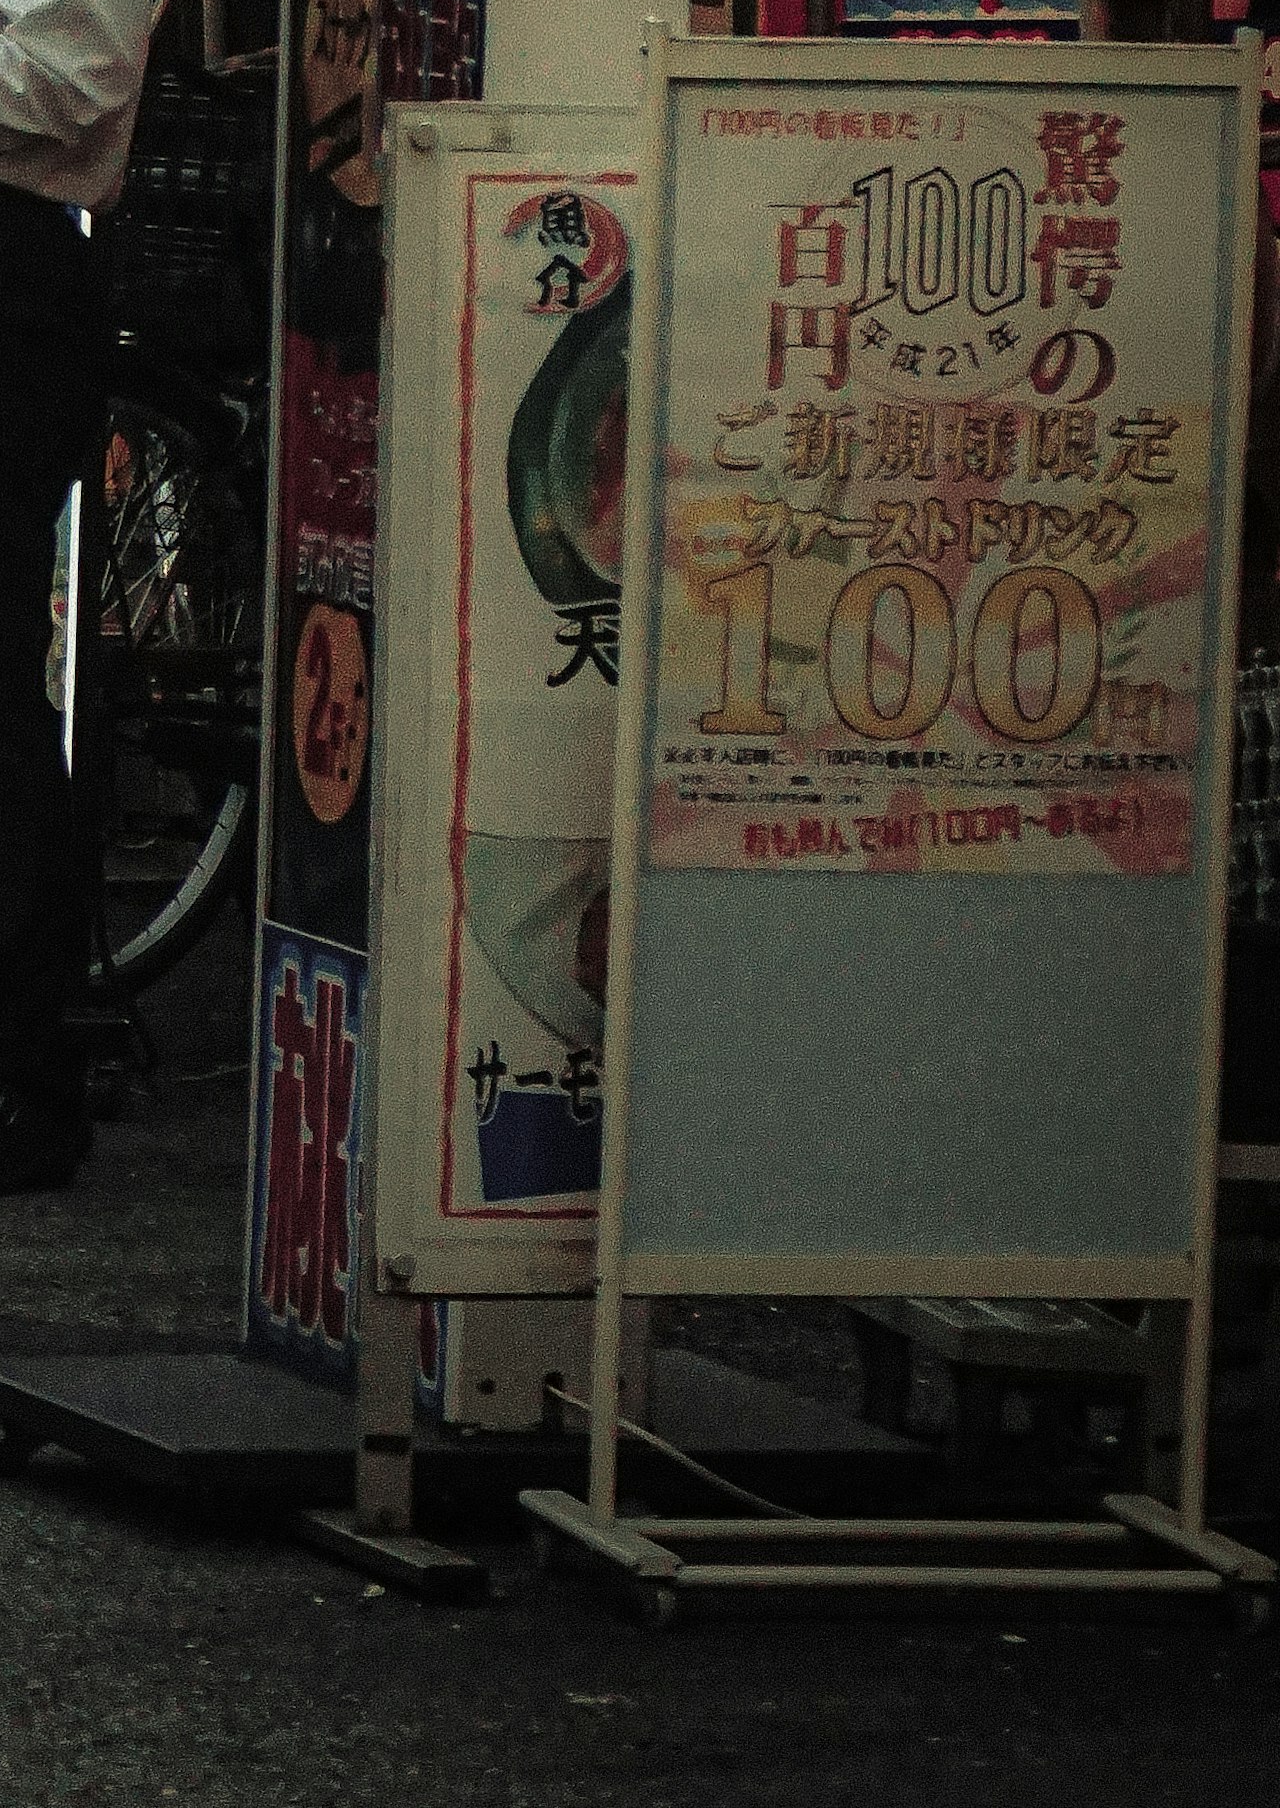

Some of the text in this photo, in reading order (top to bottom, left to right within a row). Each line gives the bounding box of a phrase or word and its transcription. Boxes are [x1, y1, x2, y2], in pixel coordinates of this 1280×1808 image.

[537, 192, 588, 310] 魚介
[766, 197, 851, 393] 百円
[851, 166, 1028, 317] 100
[1029, 109, 1126, 404] 驚愕の
[712, 400, 1180, 485] ご新規様限定
[743, 496, 1137, 563] ファーストドリンク
